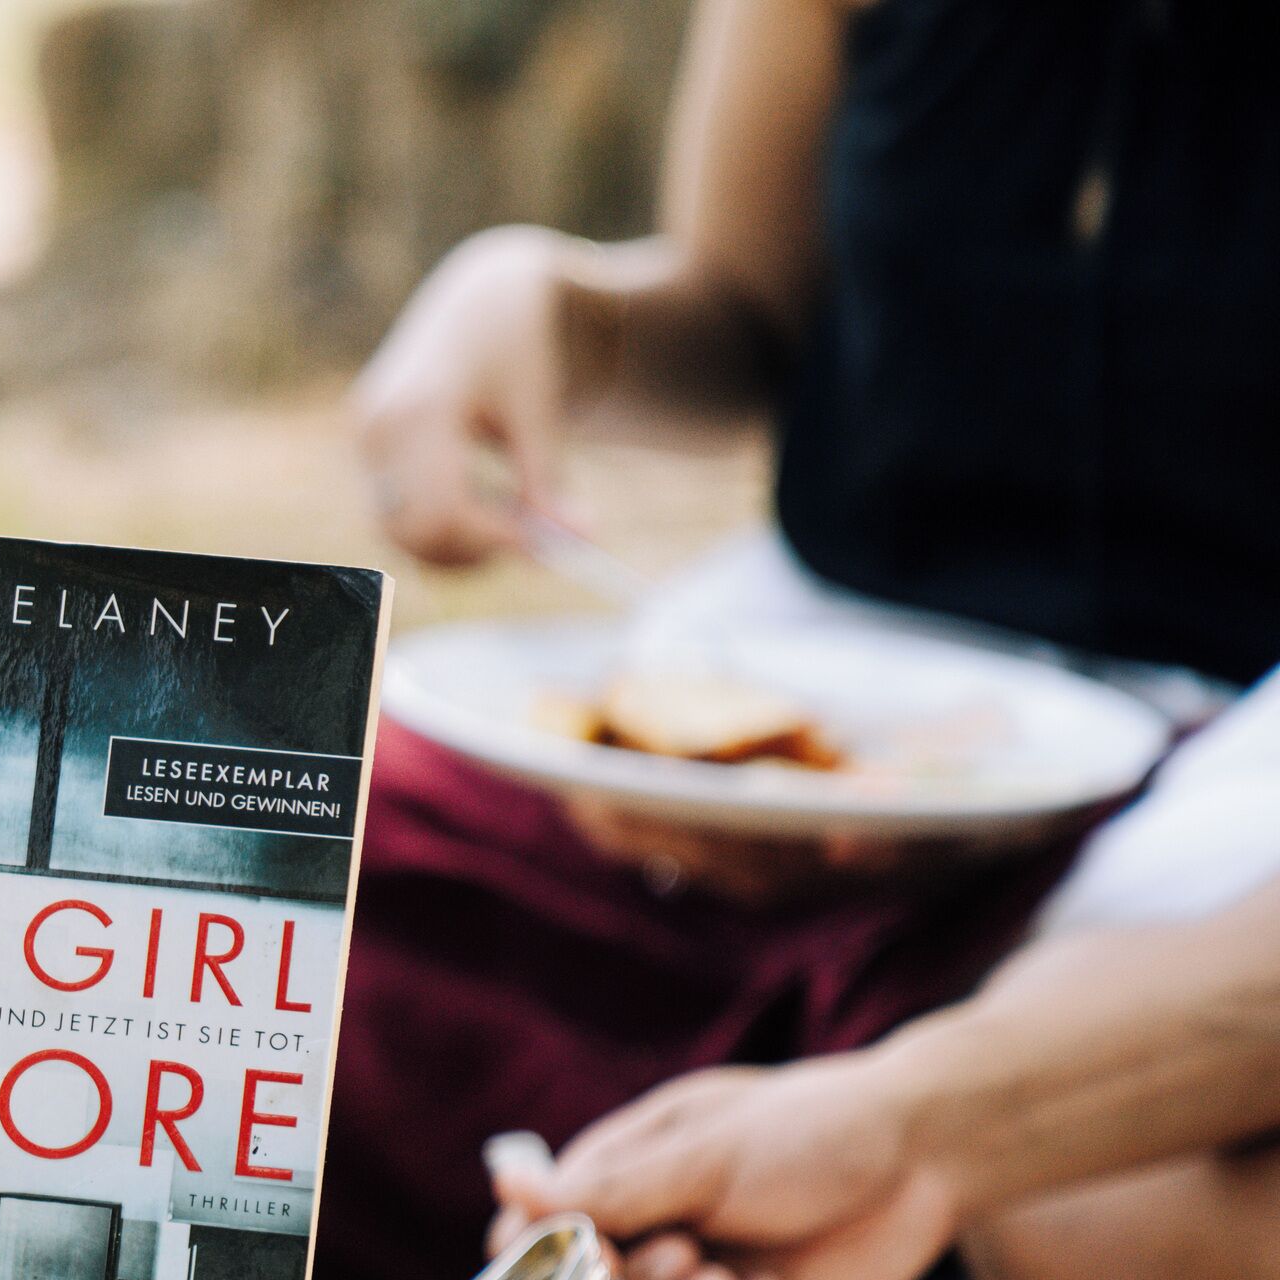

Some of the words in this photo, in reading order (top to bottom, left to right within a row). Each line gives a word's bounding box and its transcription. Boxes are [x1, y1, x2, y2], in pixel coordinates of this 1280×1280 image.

[141, 757, 330, 792] LESEEXEMPLAR
[126, 784, 180, 805] LESEN
[184, 788, 226, 809] UND
[230, 794, 340, 819] GEWINNEN!
[23, 899, 313, 1014] GIRL
[54, 1012, 135, 1037] JETZT
[146, 1020, 187, 1042] IST
[198, 1025, 241, 1048] SIE
[254, 1030, 310, 1054] TOT.
[188, 1193, 291, 1218] THRILLER
